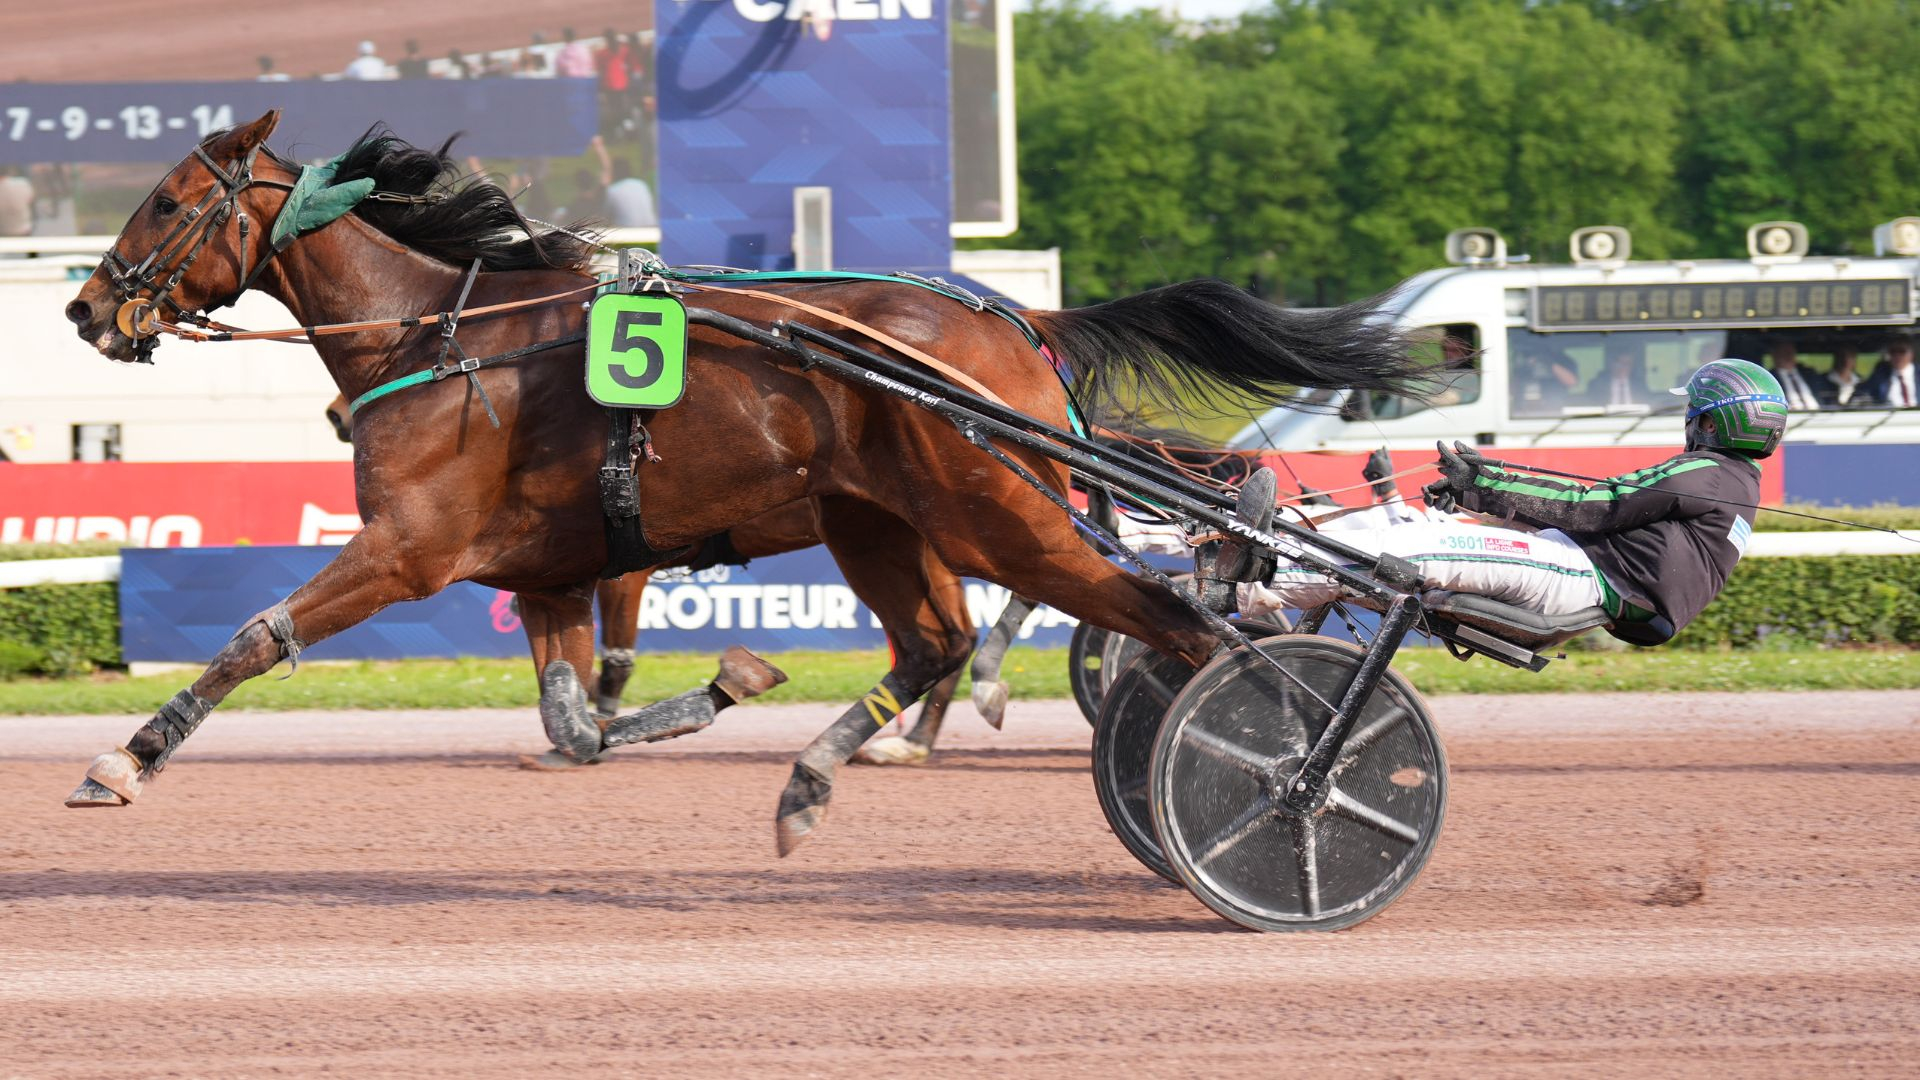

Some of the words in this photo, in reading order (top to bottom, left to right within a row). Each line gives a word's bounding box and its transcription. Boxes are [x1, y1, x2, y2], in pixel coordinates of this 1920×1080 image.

[607, 310, 665, 389] 5
[864, 370, 918, 397] Champenois
[1447, 535, 1483, 550] 3601
[637, 584, 858, 629] ROTTEUR
